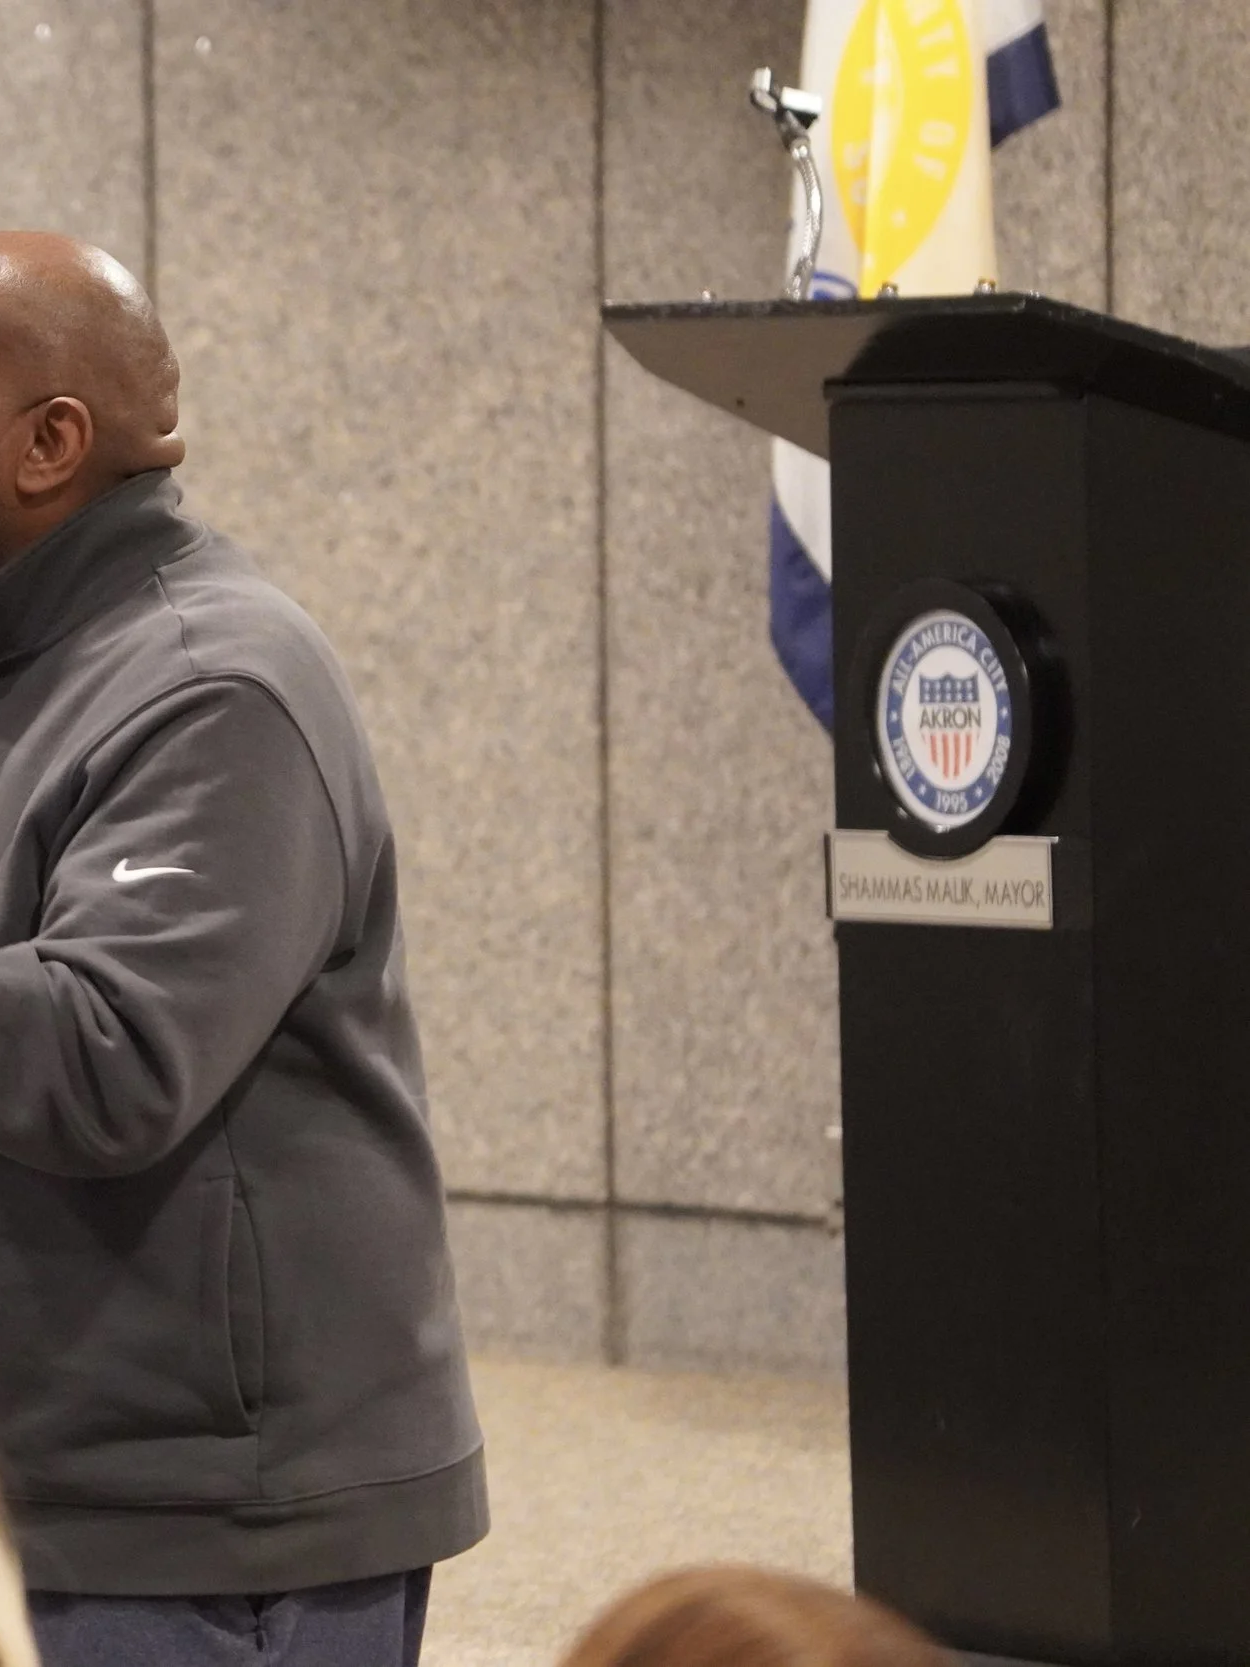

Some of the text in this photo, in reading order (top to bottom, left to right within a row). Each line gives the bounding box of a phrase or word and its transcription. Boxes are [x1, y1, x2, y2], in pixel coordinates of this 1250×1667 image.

[891, 622, 1009, 695] ALL-AMERICA CITY
[919, 706, 982, 729] AKRON
[987, 735, 1011, 786] 2008
[936, 790, 968, 812] 1995
[838, 872, 1046, 909] SHAMMAS MALIK, MAYOR
